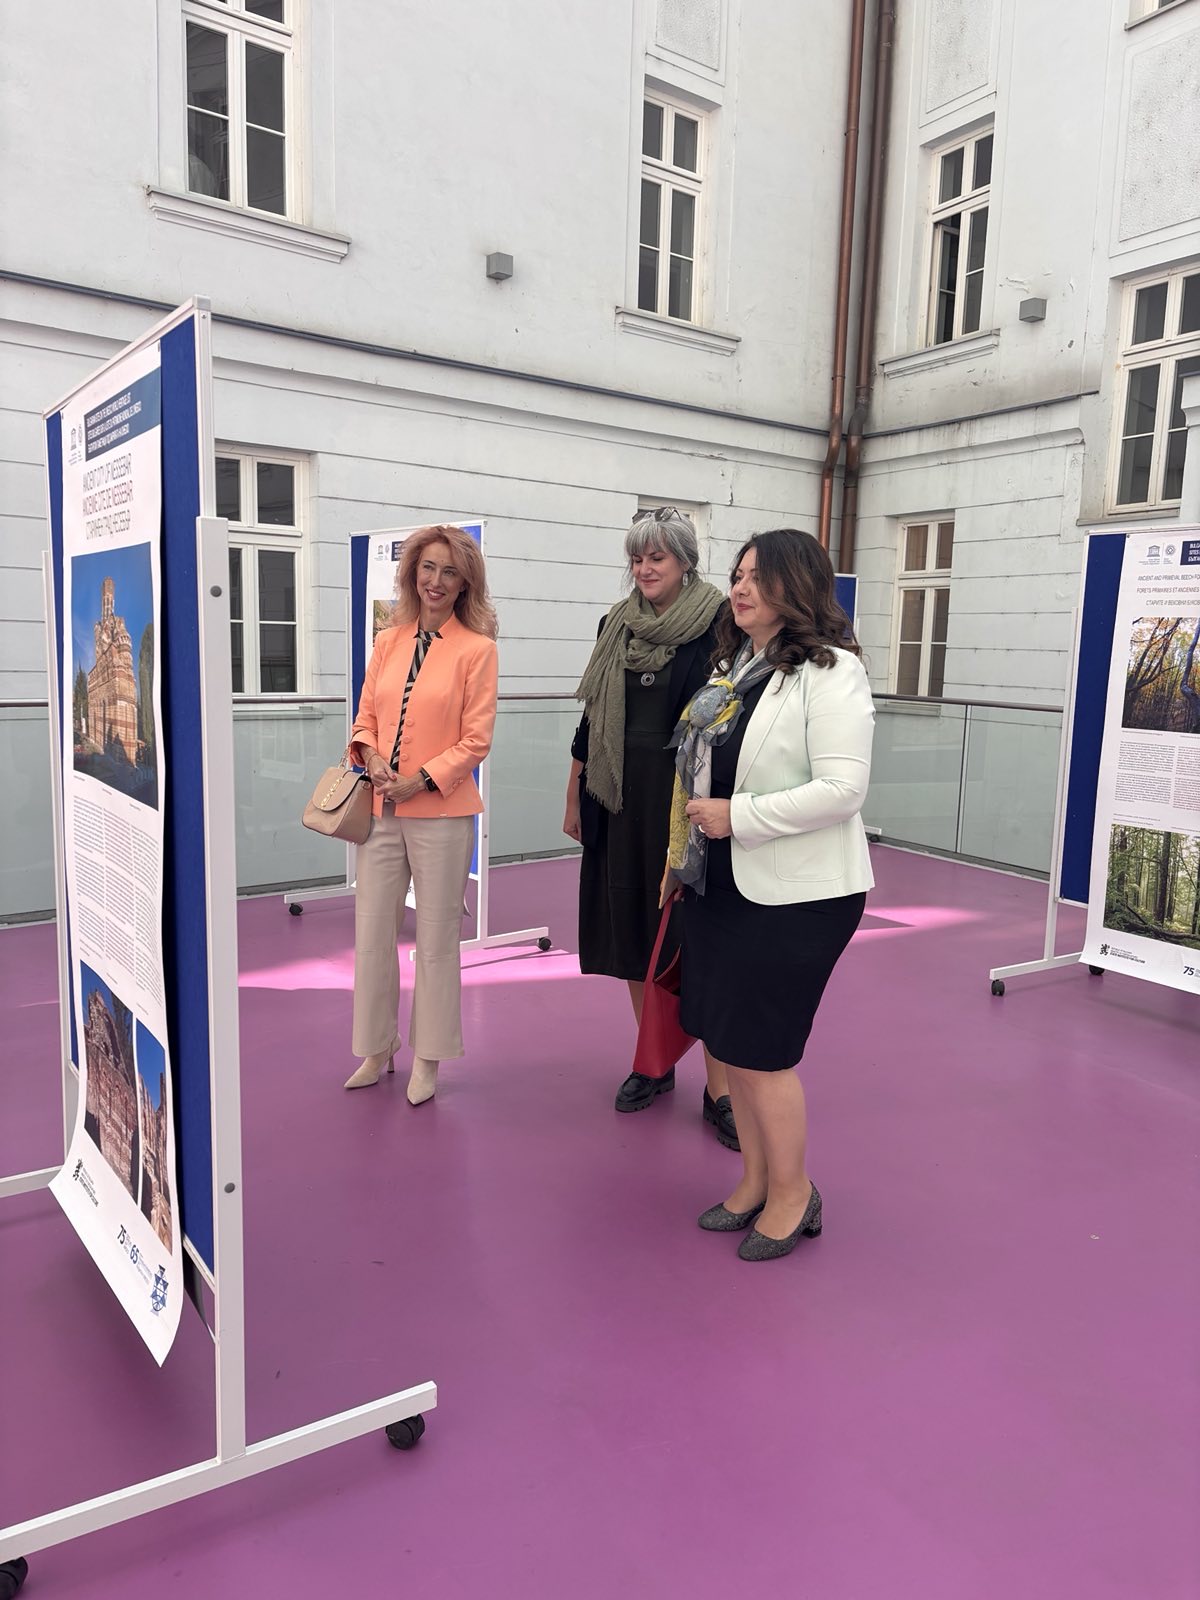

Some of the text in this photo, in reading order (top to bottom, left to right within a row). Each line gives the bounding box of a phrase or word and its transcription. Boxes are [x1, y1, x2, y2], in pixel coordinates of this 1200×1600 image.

[1183, 965, 1195, 976] 75
[117, 1224, 140, 1265] 75 65
